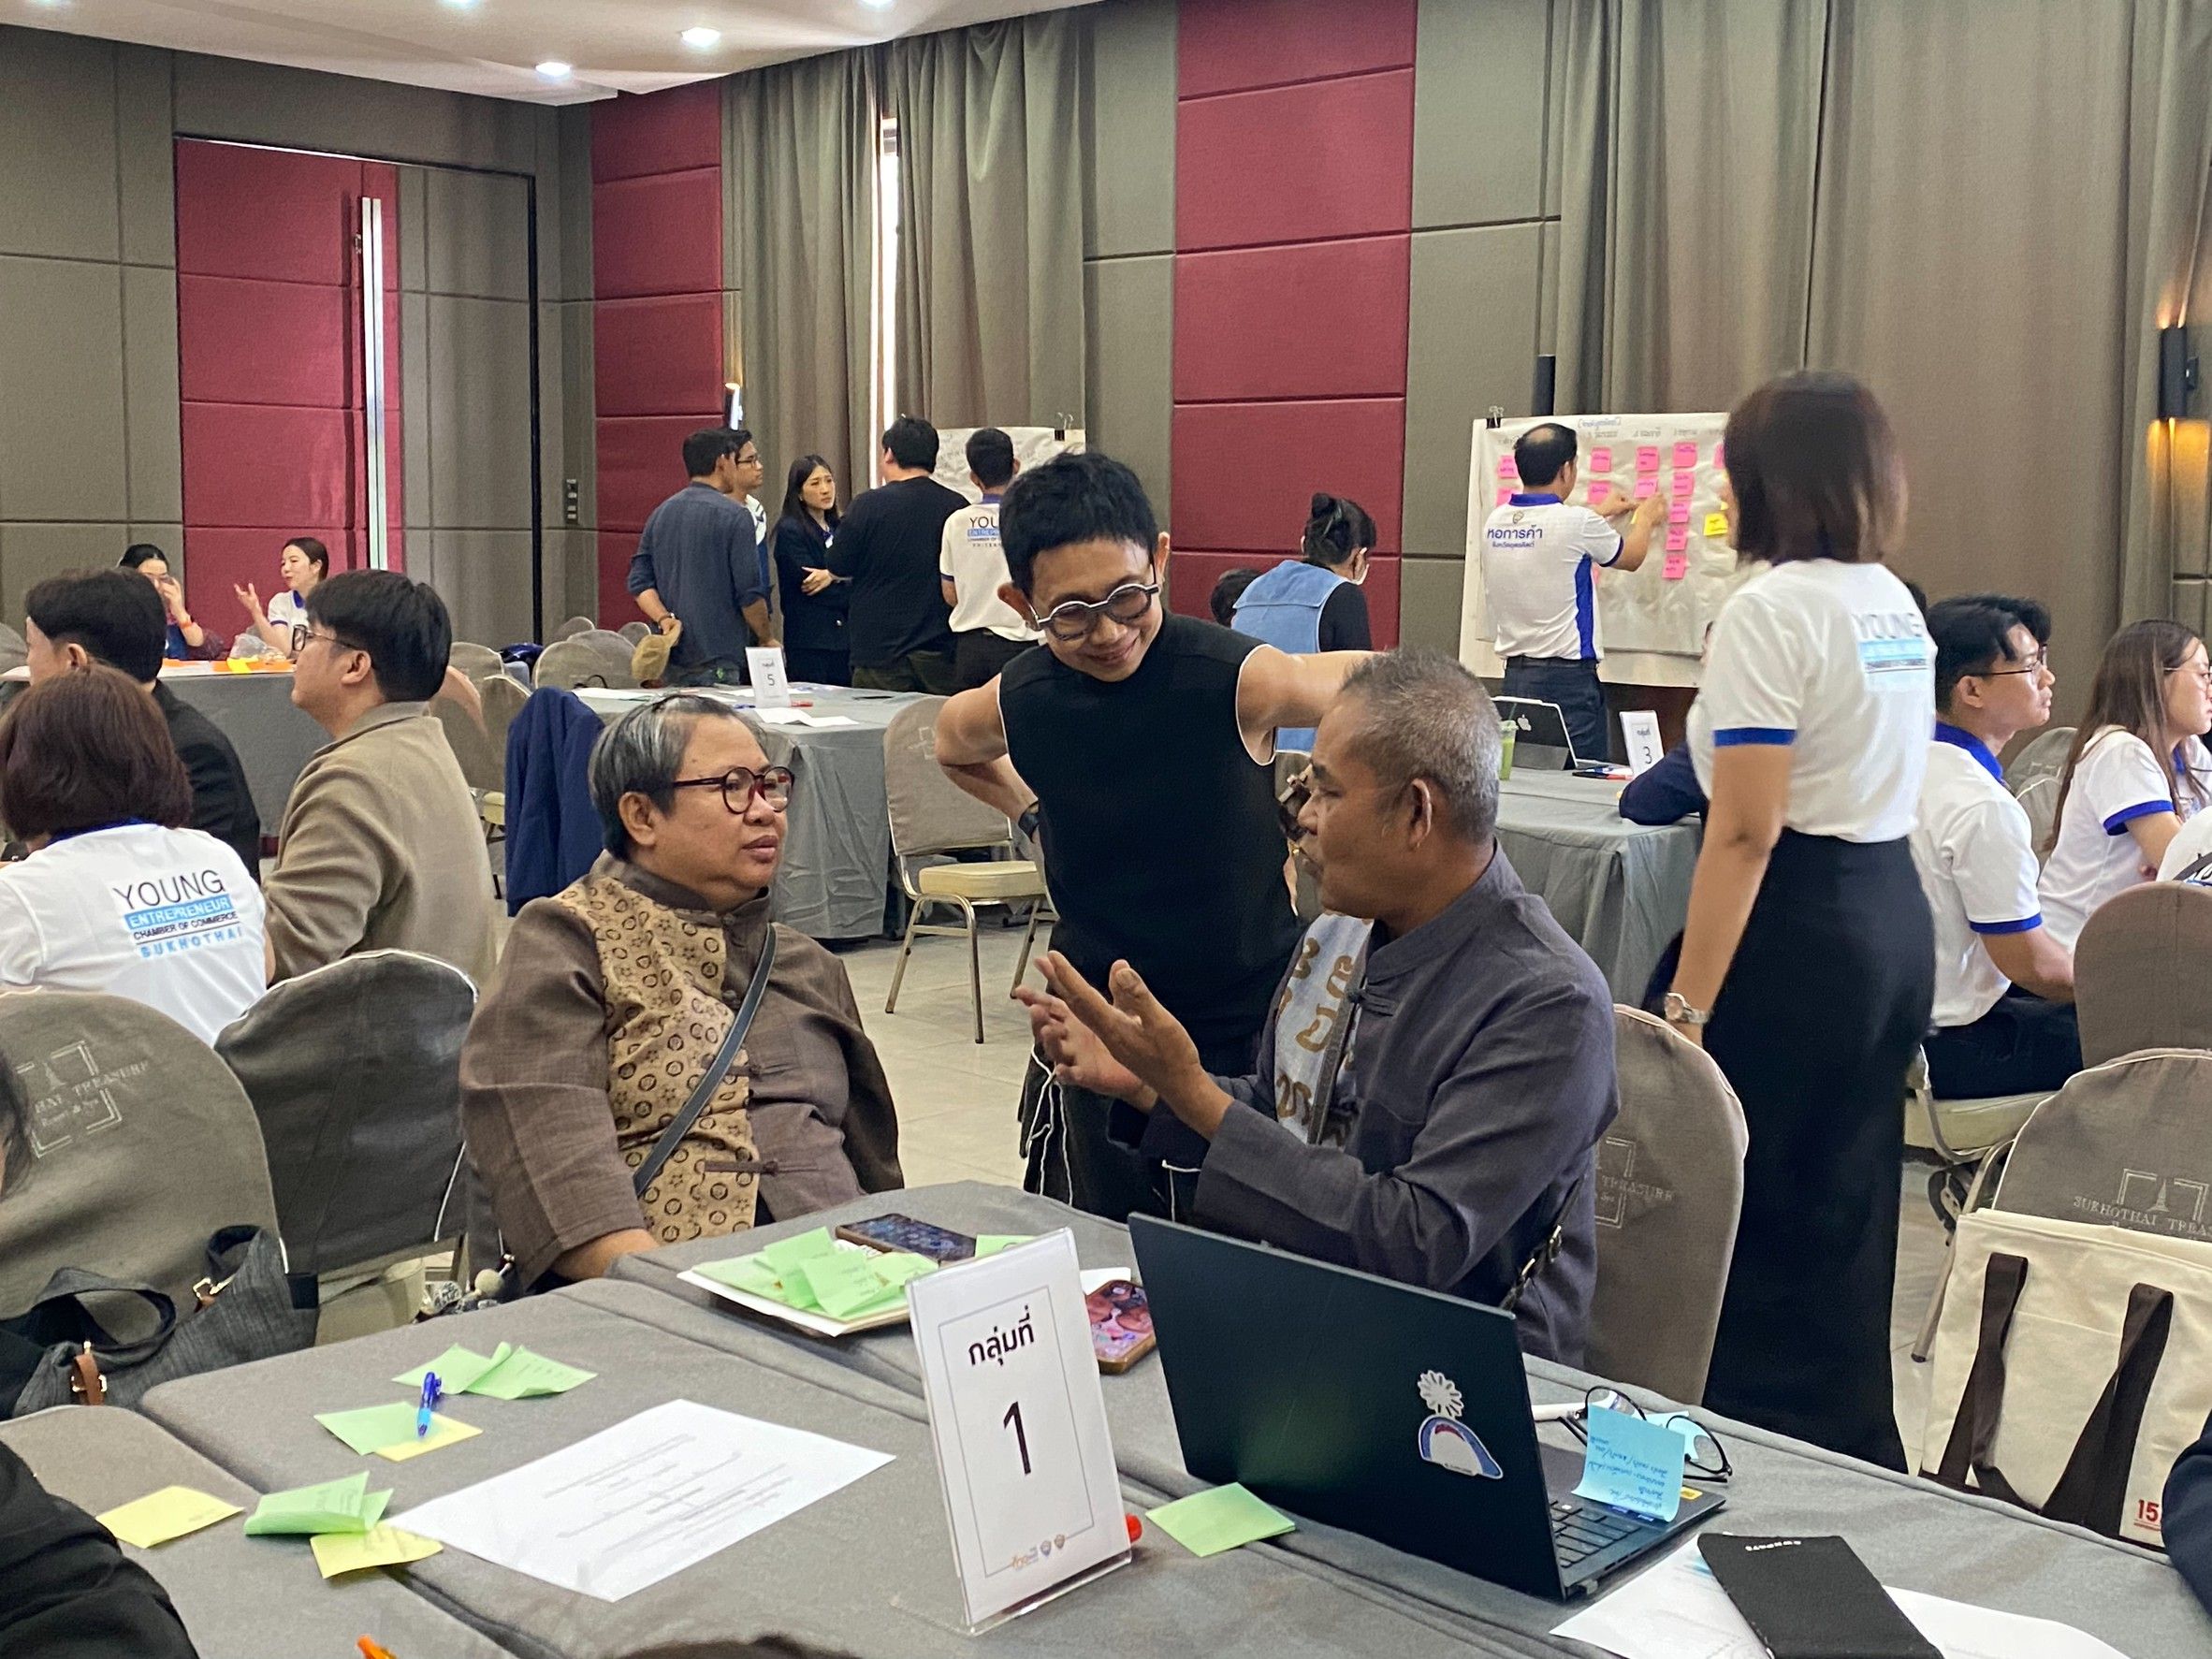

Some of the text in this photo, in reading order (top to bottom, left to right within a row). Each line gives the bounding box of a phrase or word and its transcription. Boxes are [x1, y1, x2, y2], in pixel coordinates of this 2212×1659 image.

[969, 517, 998, 529] YOU
[1487, 524, 1543, 539] หอการค้า
[1852, 612, 1923, 639] YOUNG
[767, 674, 776, 687] 5
[1643, 746, 1652, 764] 3
[112, 869, 226, 910] YOUNG
[129, 897, 230, 928] ENTREPRENEUR
[133, 911, 239, 940] CHAMBER OF COMMERCE
[140, 926, 242, 958] SUKHOTHAI
[2074, 1196, 2157, 1226] SUKHOTHAI
[968, 1305, 1035, 1366] กลุ่มที่
[1003, 1401, 1031, 1477] 1
